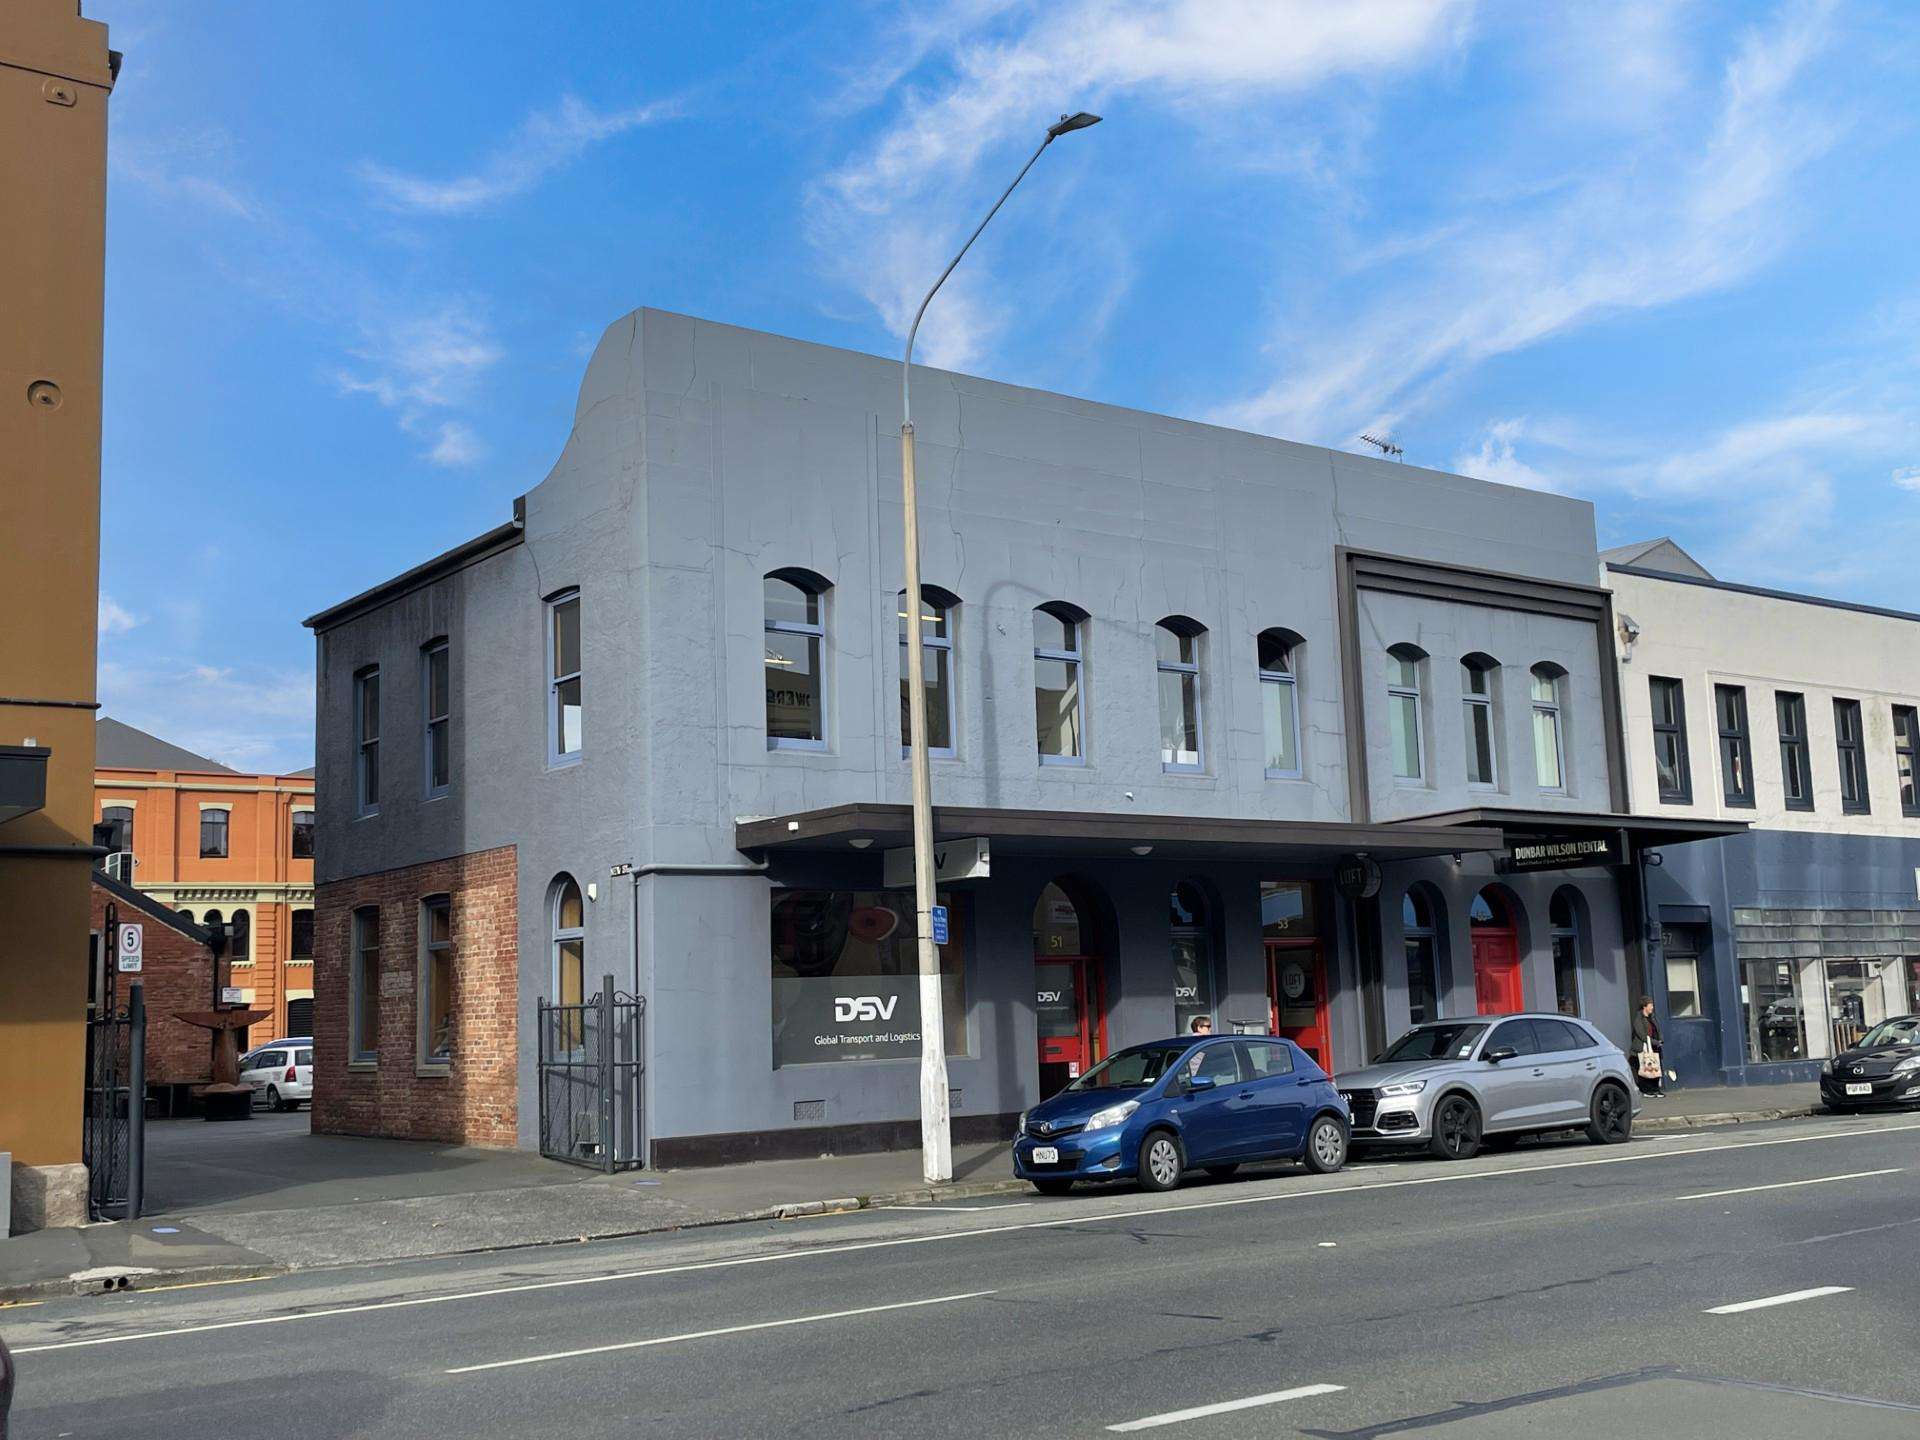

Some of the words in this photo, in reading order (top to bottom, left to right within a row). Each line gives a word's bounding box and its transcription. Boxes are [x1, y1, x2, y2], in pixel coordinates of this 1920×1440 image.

[1515, 846, 1545, 860] DUNBAR
[1547, 843, 1576, 857] WILSON
[1578, 840, 1608, 853] DENTAL
[1278, 918, 1289, 929] 53
[127, 931, 134, 947] 5
[1051, 935, 1063, 948] 51
[1037, 991, 1061, 1002] DSV
[1175, 987, 1197, 997] DSV
[835, 995, 898, 1022] DSV
[814, 1035, 838, 1046] Global
[840, 1034, 873, 1045] Transport
[875, 1032, 889, 1043] and
[890, 1031, 920, 1044] Logistics
